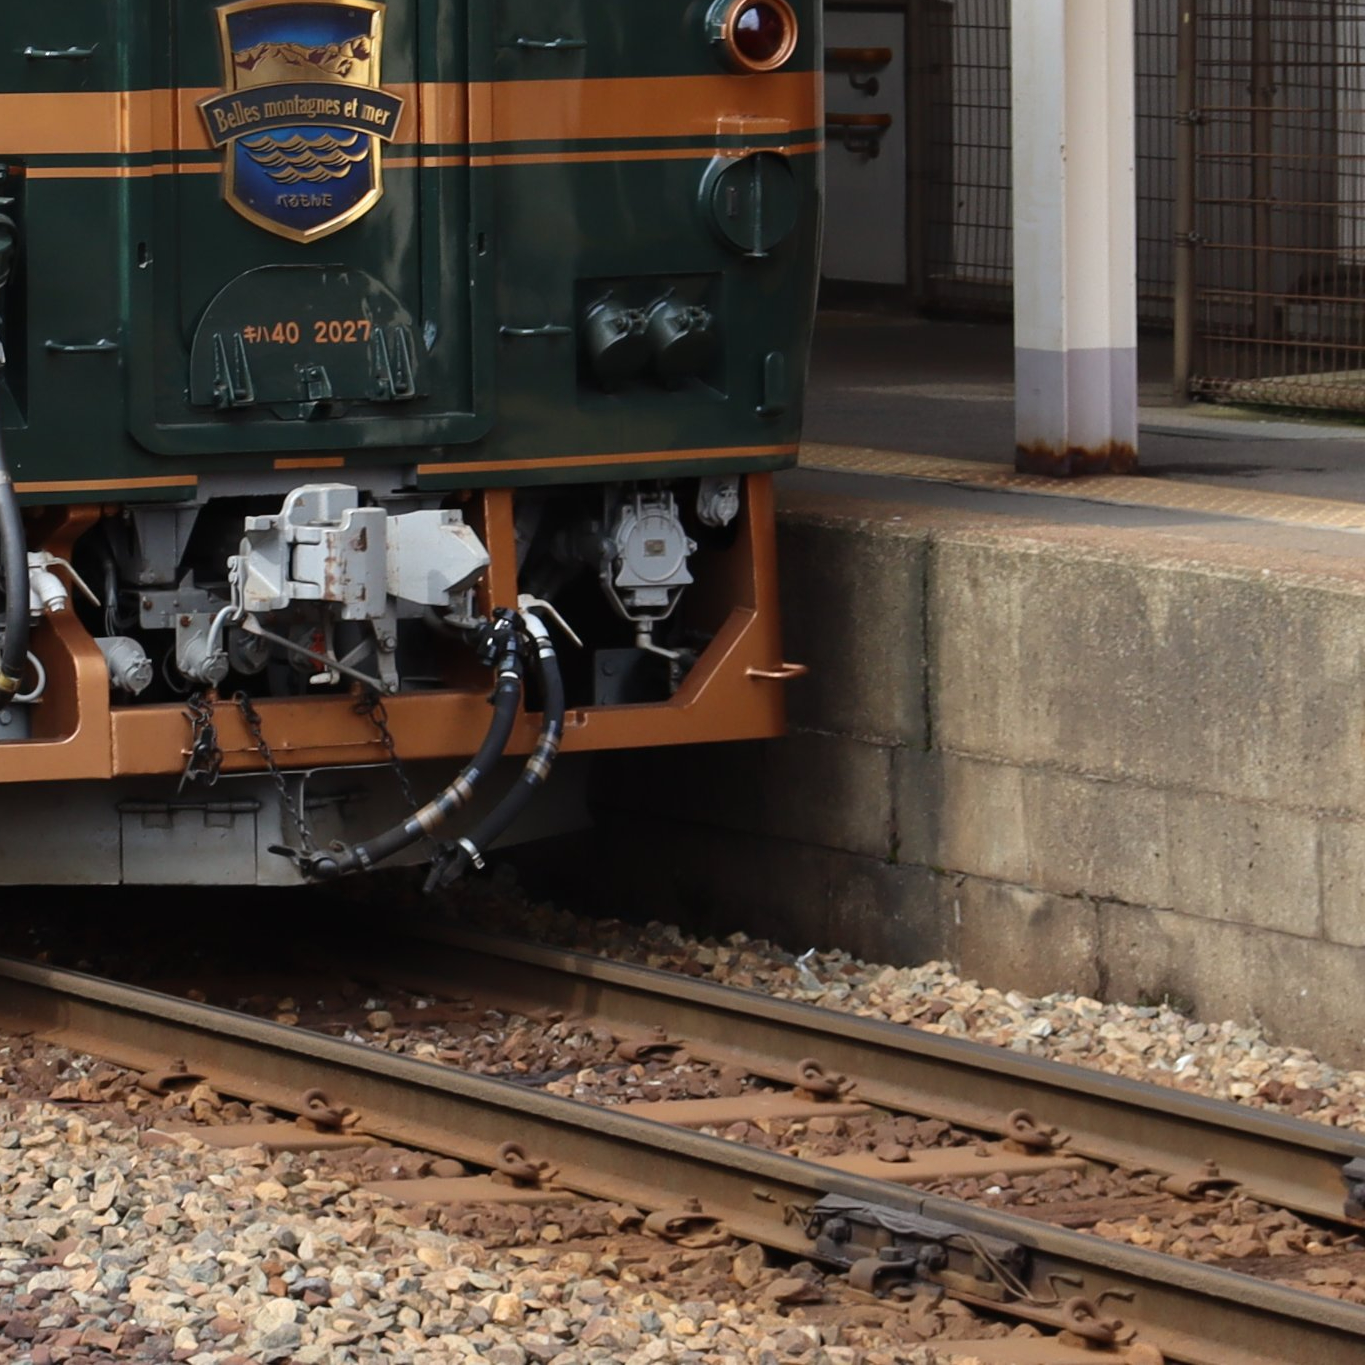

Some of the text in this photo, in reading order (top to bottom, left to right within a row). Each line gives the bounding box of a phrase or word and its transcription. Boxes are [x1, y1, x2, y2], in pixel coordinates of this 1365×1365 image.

[212, 94, 391, 134] Belles montagnes et mer
[314, 319, 372, 344] 2027
